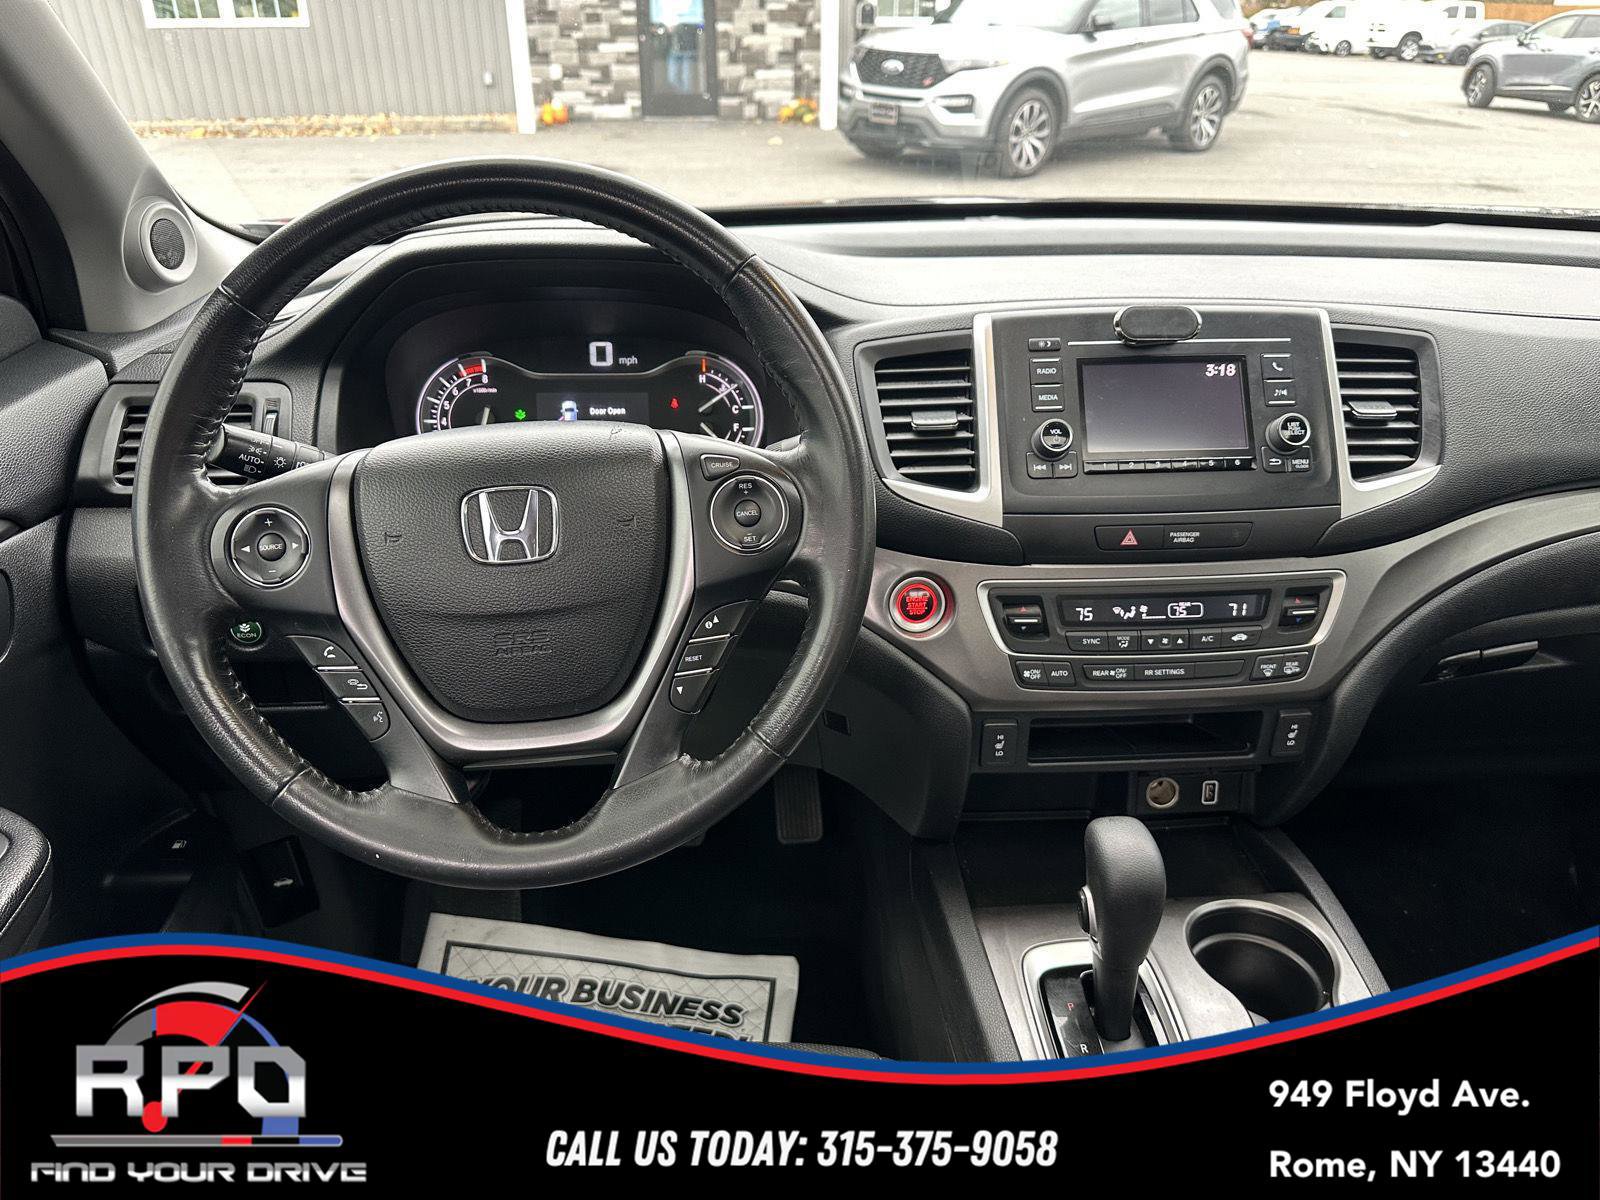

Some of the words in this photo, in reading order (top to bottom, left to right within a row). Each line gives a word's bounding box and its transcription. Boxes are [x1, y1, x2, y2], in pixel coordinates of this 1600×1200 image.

[589, 341, 613, 367] 0
[618, 355, 638, 366] mph
[1036, 367, 1057, 375] RADIO
[1205, 363, 1236, 377] 3:18
[466, 378, 472, 388] 7
[481, 374, 489, 384] 8
[698, 374, 706, 384] H
[452, 386, 459, 396] 6
[443, 400, 450, 410] 5
[731, 404, 740, 414] C
[589, 407, 607, 416] Door
[607, 406, 626, 416] Open
[441, 416, 448, 426] 4
[732, 422, 740, 432] F
[238, 453, 261, 465] AUTO
[1208, 459, 1215, 467] 5
[710, 460, 733, 469] CRUISE
[1128, 461, 1135, 469] 2
[738, 482, 753, 490] RES
[736, 508, 759, 517] CANCEL
[743, 535, 757, 543] SET
[259, 543, 283, 551] SOURCE
[1075, 607, 1094, 621] 75
[1172, 606, 1188, 617] 75
[1228, 602, 1248, 617] 71
[236, 631, 257, 639] ECON
[684, 655, 703, 663] RESET
[1154, 668, 1185, 676] SETTINGS
[570, 978, 744, 1024] BUSINESS
[1067, 1002, 1075, 1012] P
[1080, 1043, 1089, 1054] R
